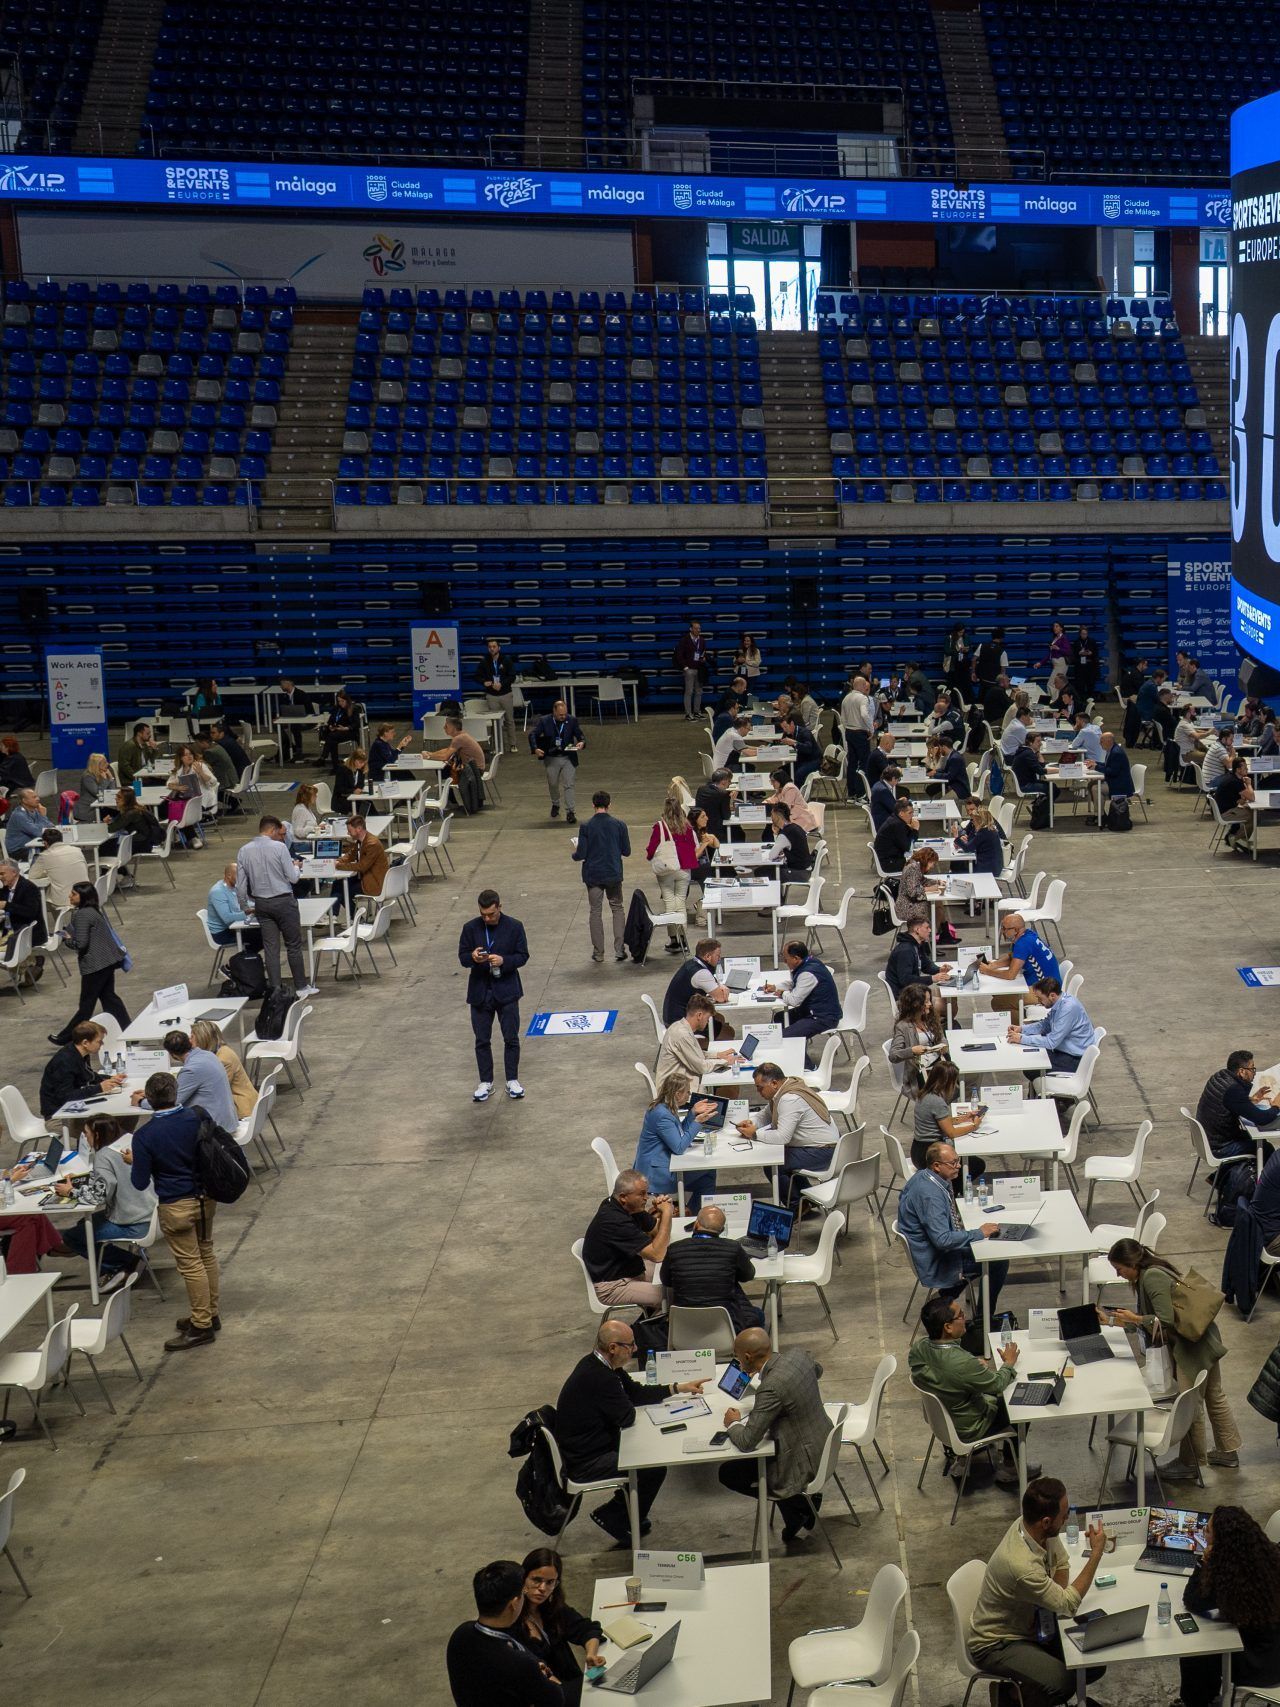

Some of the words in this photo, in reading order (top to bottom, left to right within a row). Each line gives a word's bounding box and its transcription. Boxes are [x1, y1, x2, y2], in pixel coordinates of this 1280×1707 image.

[165, 167, 229, 180] SPORTS
[17, 172, 65, 187] VIP
[166, 179, 230, 190] &EVENTS
[391, 181, 421, 189] Ciudad
[484, 178, 532, 201] SPORTS
[696, 189, 723, 198] Ciudad
[931, 188, 985, 200] SPORTS
[177, 191, 221, 200] EUROPE
[392, 190, 402, 198] de
[404, 190, 433, 199] Málaga
[708, 198, 735, 207] Málaga
[804, 195, 846, 207] VIP
[931, 199, 986, 210] &EVENTS
[1124, 199, 1150, 207] Ciudad
[940, 211, 977, 219] EUROPE
[1135, 208, 1160, 216] Málaga
[742, 228, 789, 246] SALIDA
[1246, 236, 1278, 262] EUROPE
[1184, 561, 1232, 573] SPORT
[1184, 572, 1232, 582] &EVENT
[426, 630, 443, 649] A
[418, 655, 425, 664] B
[51, 661, 74, 669] Work
[76, 661, 99, 669] Area
[418, 664, 426, 673] C
[419, 674, 427, 683] D
[55, 681, 64, 690] A
[56, 691, 63, 700] B
[56, 701, 65, 711] C
[57, 711, 66, 721] D
[695, 1350, 712, 1358] C46
[1130, 1508, 1148, 1518] C57
[677, 1554, 696, 1563] C56
